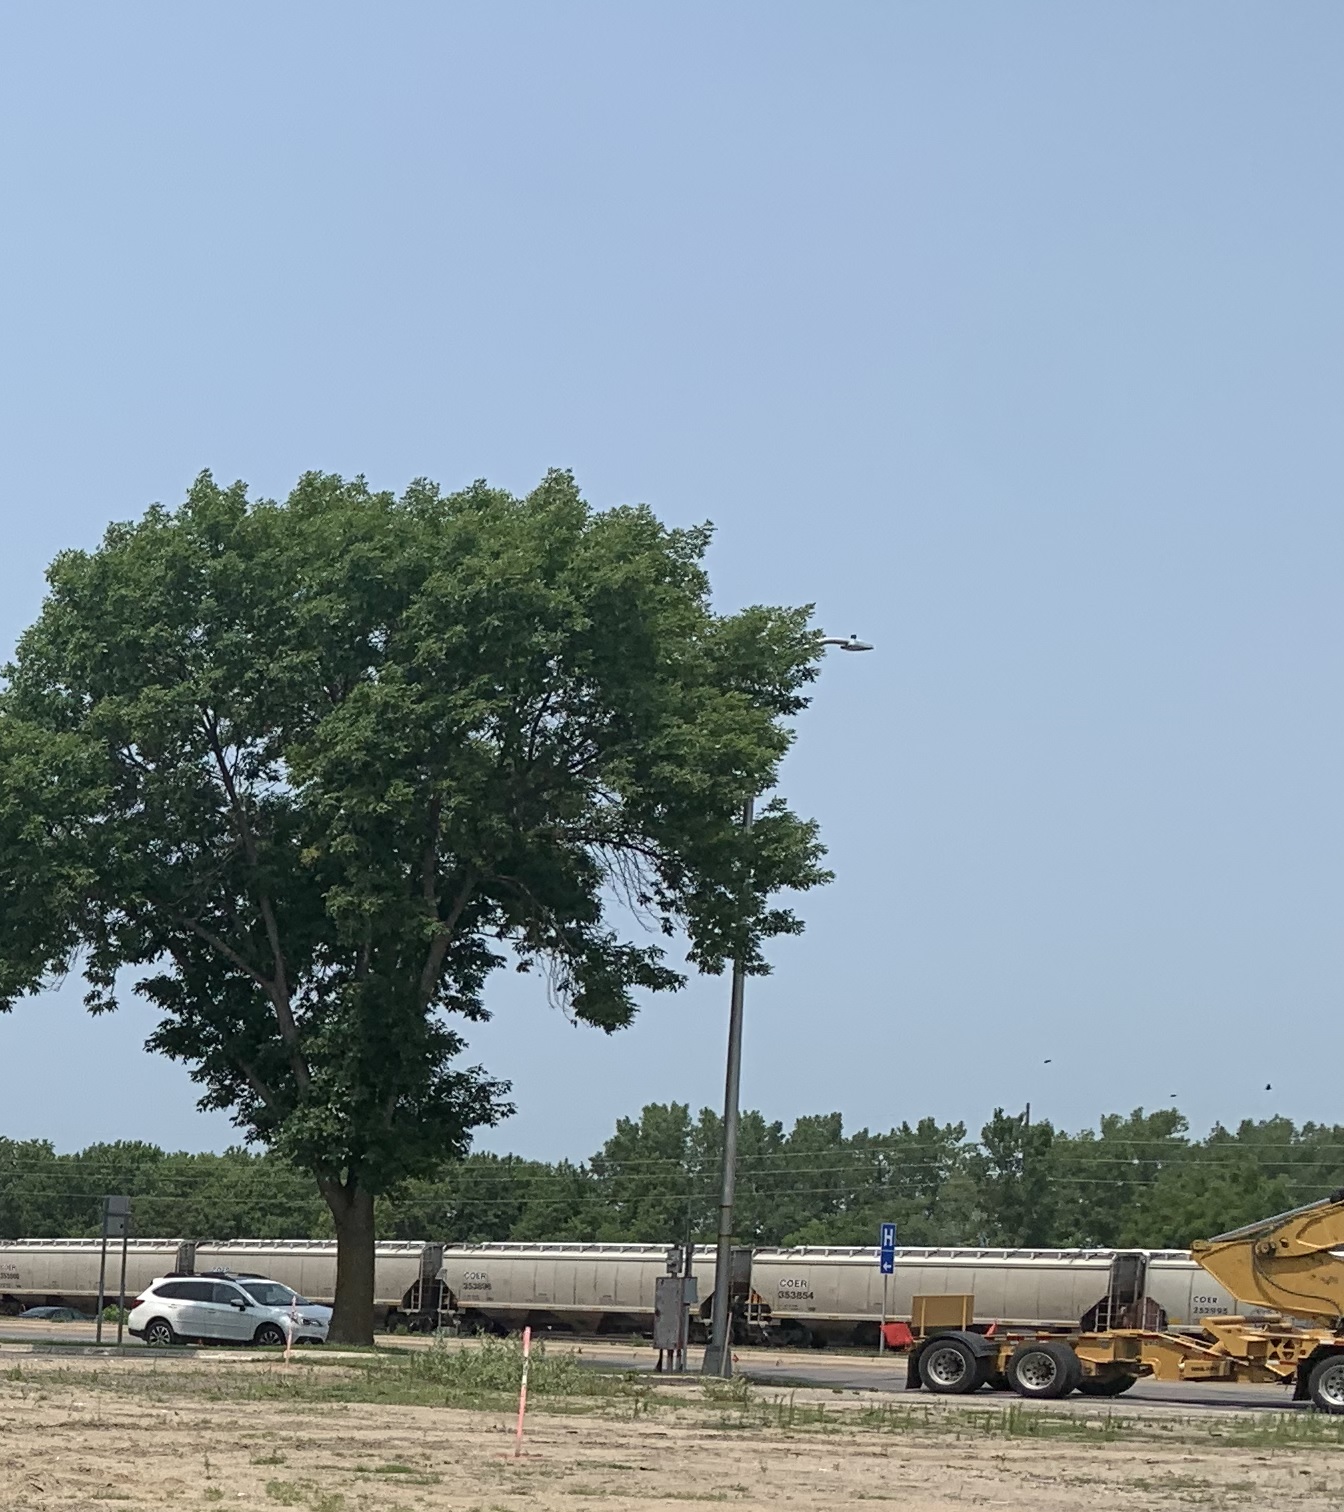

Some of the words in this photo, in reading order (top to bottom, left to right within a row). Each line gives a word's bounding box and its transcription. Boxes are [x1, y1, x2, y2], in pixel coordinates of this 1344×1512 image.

[884, 1228, 894, 1247] H
[463, 1271, 487, 1280] COER
[779, 1279, 808, 1288] COER
[1193, 1295, 1218, 1304] COER
